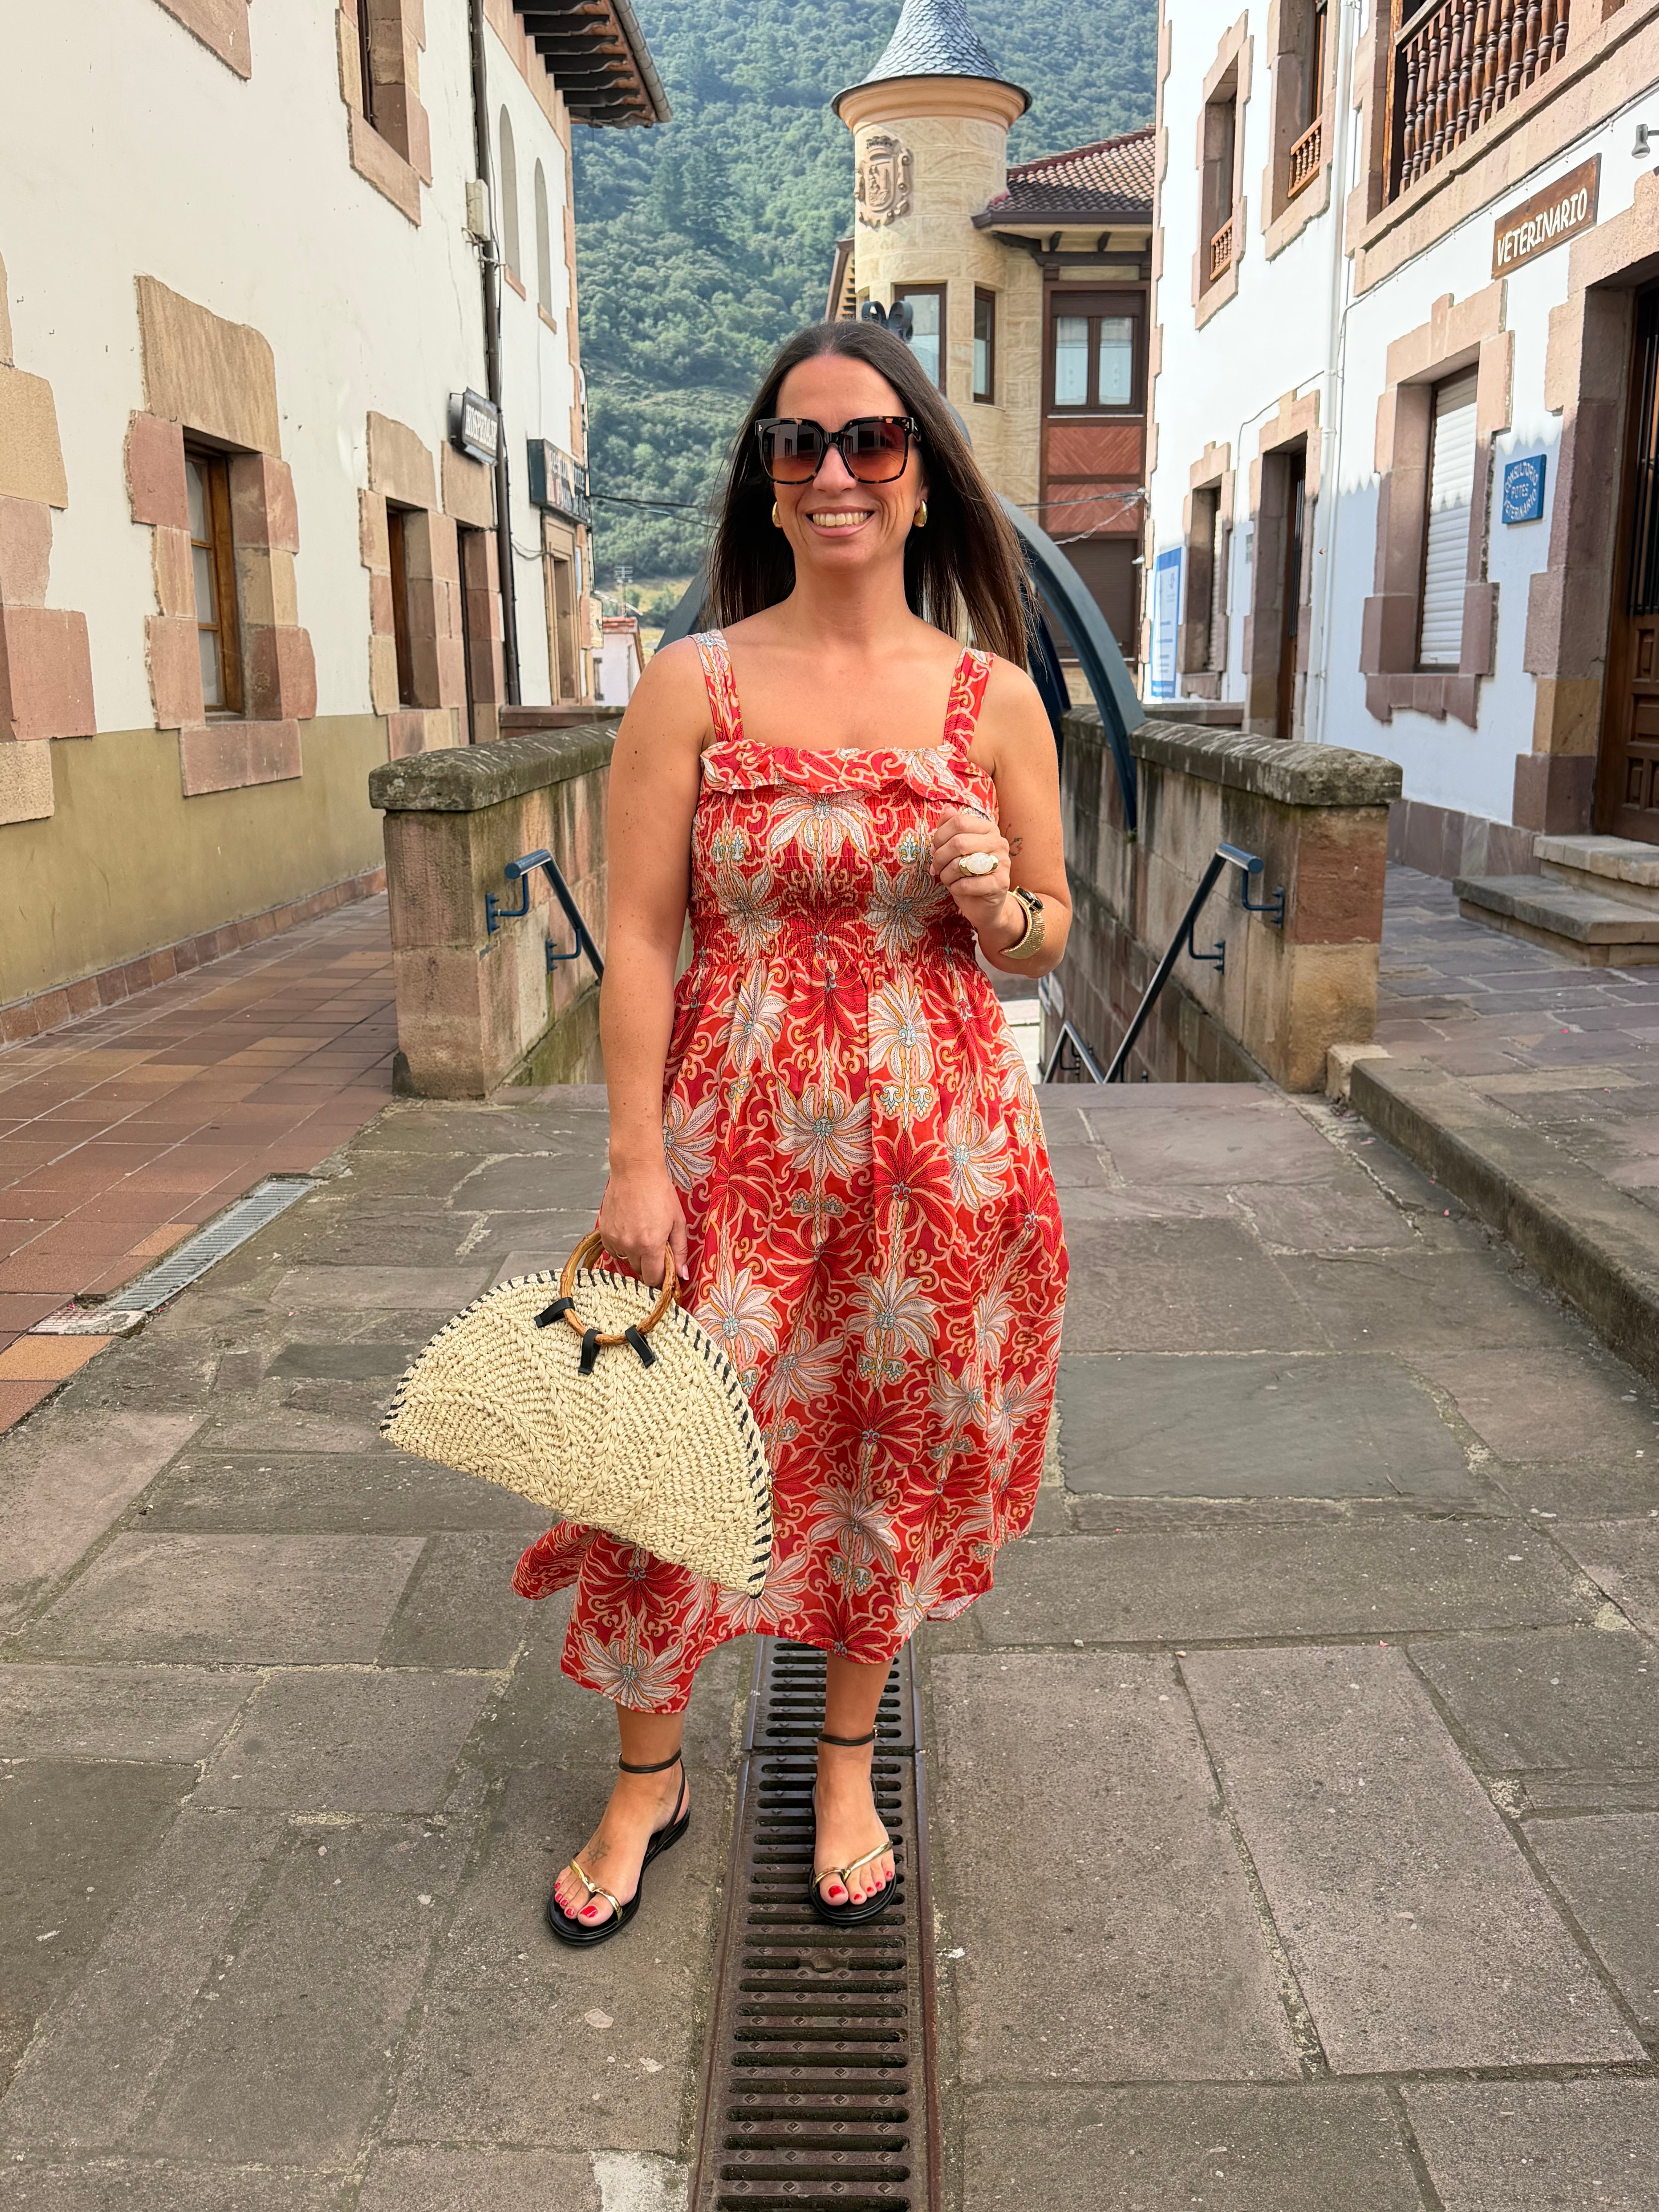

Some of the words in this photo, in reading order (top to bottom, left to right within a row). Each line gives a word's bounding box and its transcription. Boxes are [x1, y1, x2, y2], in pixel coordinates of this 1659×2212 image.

[1497, 187, 1587, 266] VETERINARIO
[1505, 461, 1539, 494] CONSULTORIO
[1511, 483, 1528, 499] POTES
[1503, 488, 1537, 520] VETERINARIO
